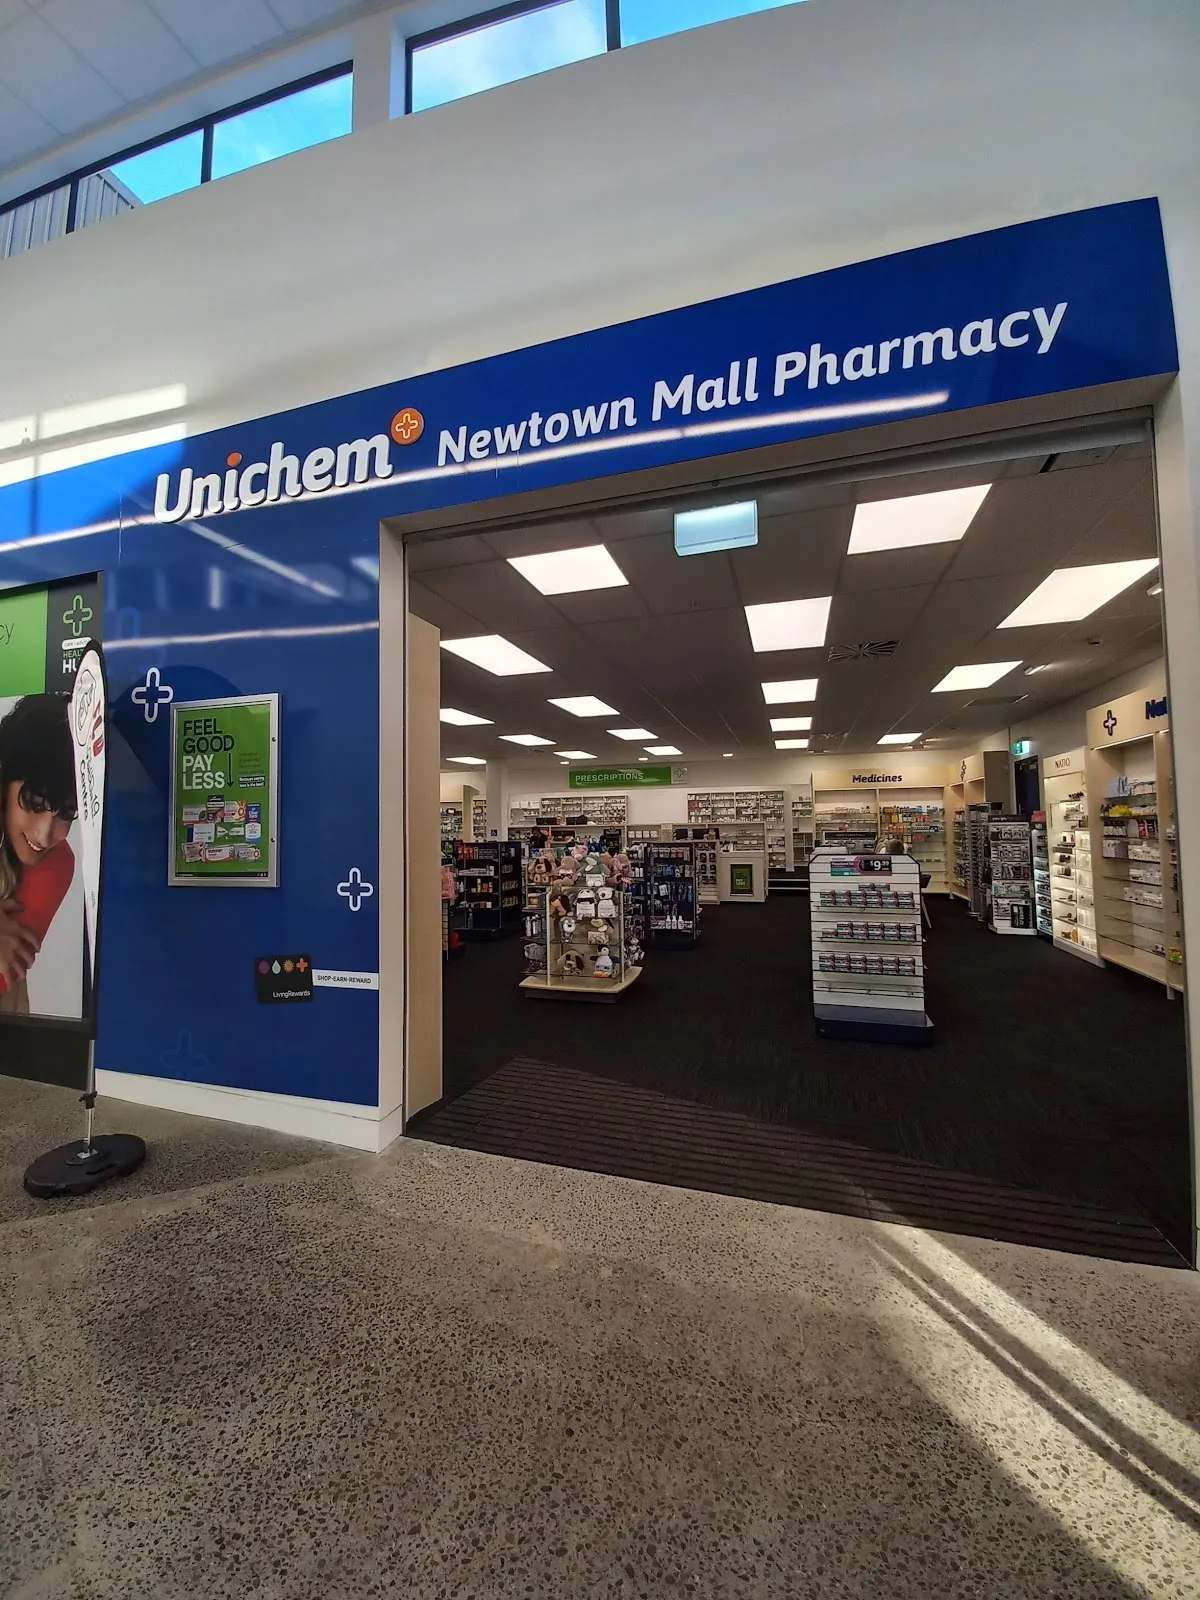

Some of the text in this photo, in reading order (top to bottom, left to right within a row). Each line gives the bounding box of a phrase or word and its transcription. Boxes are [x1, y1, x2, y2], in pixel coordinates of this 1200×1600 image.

[437, 302, 1068, 467] Newtown Mall Pharmacy
[154, 434, 394, 523] Unichem
[183, 718, 223, 736] FEEL
[183, 735, 235, 754] GOOD
[182, 754, 214, 772] PAY
[182, 771, 225, 790] LESS
[575, 773, 643, 782] PRESCRIPTIONS
[852, 773, 903, 783] Medicines
